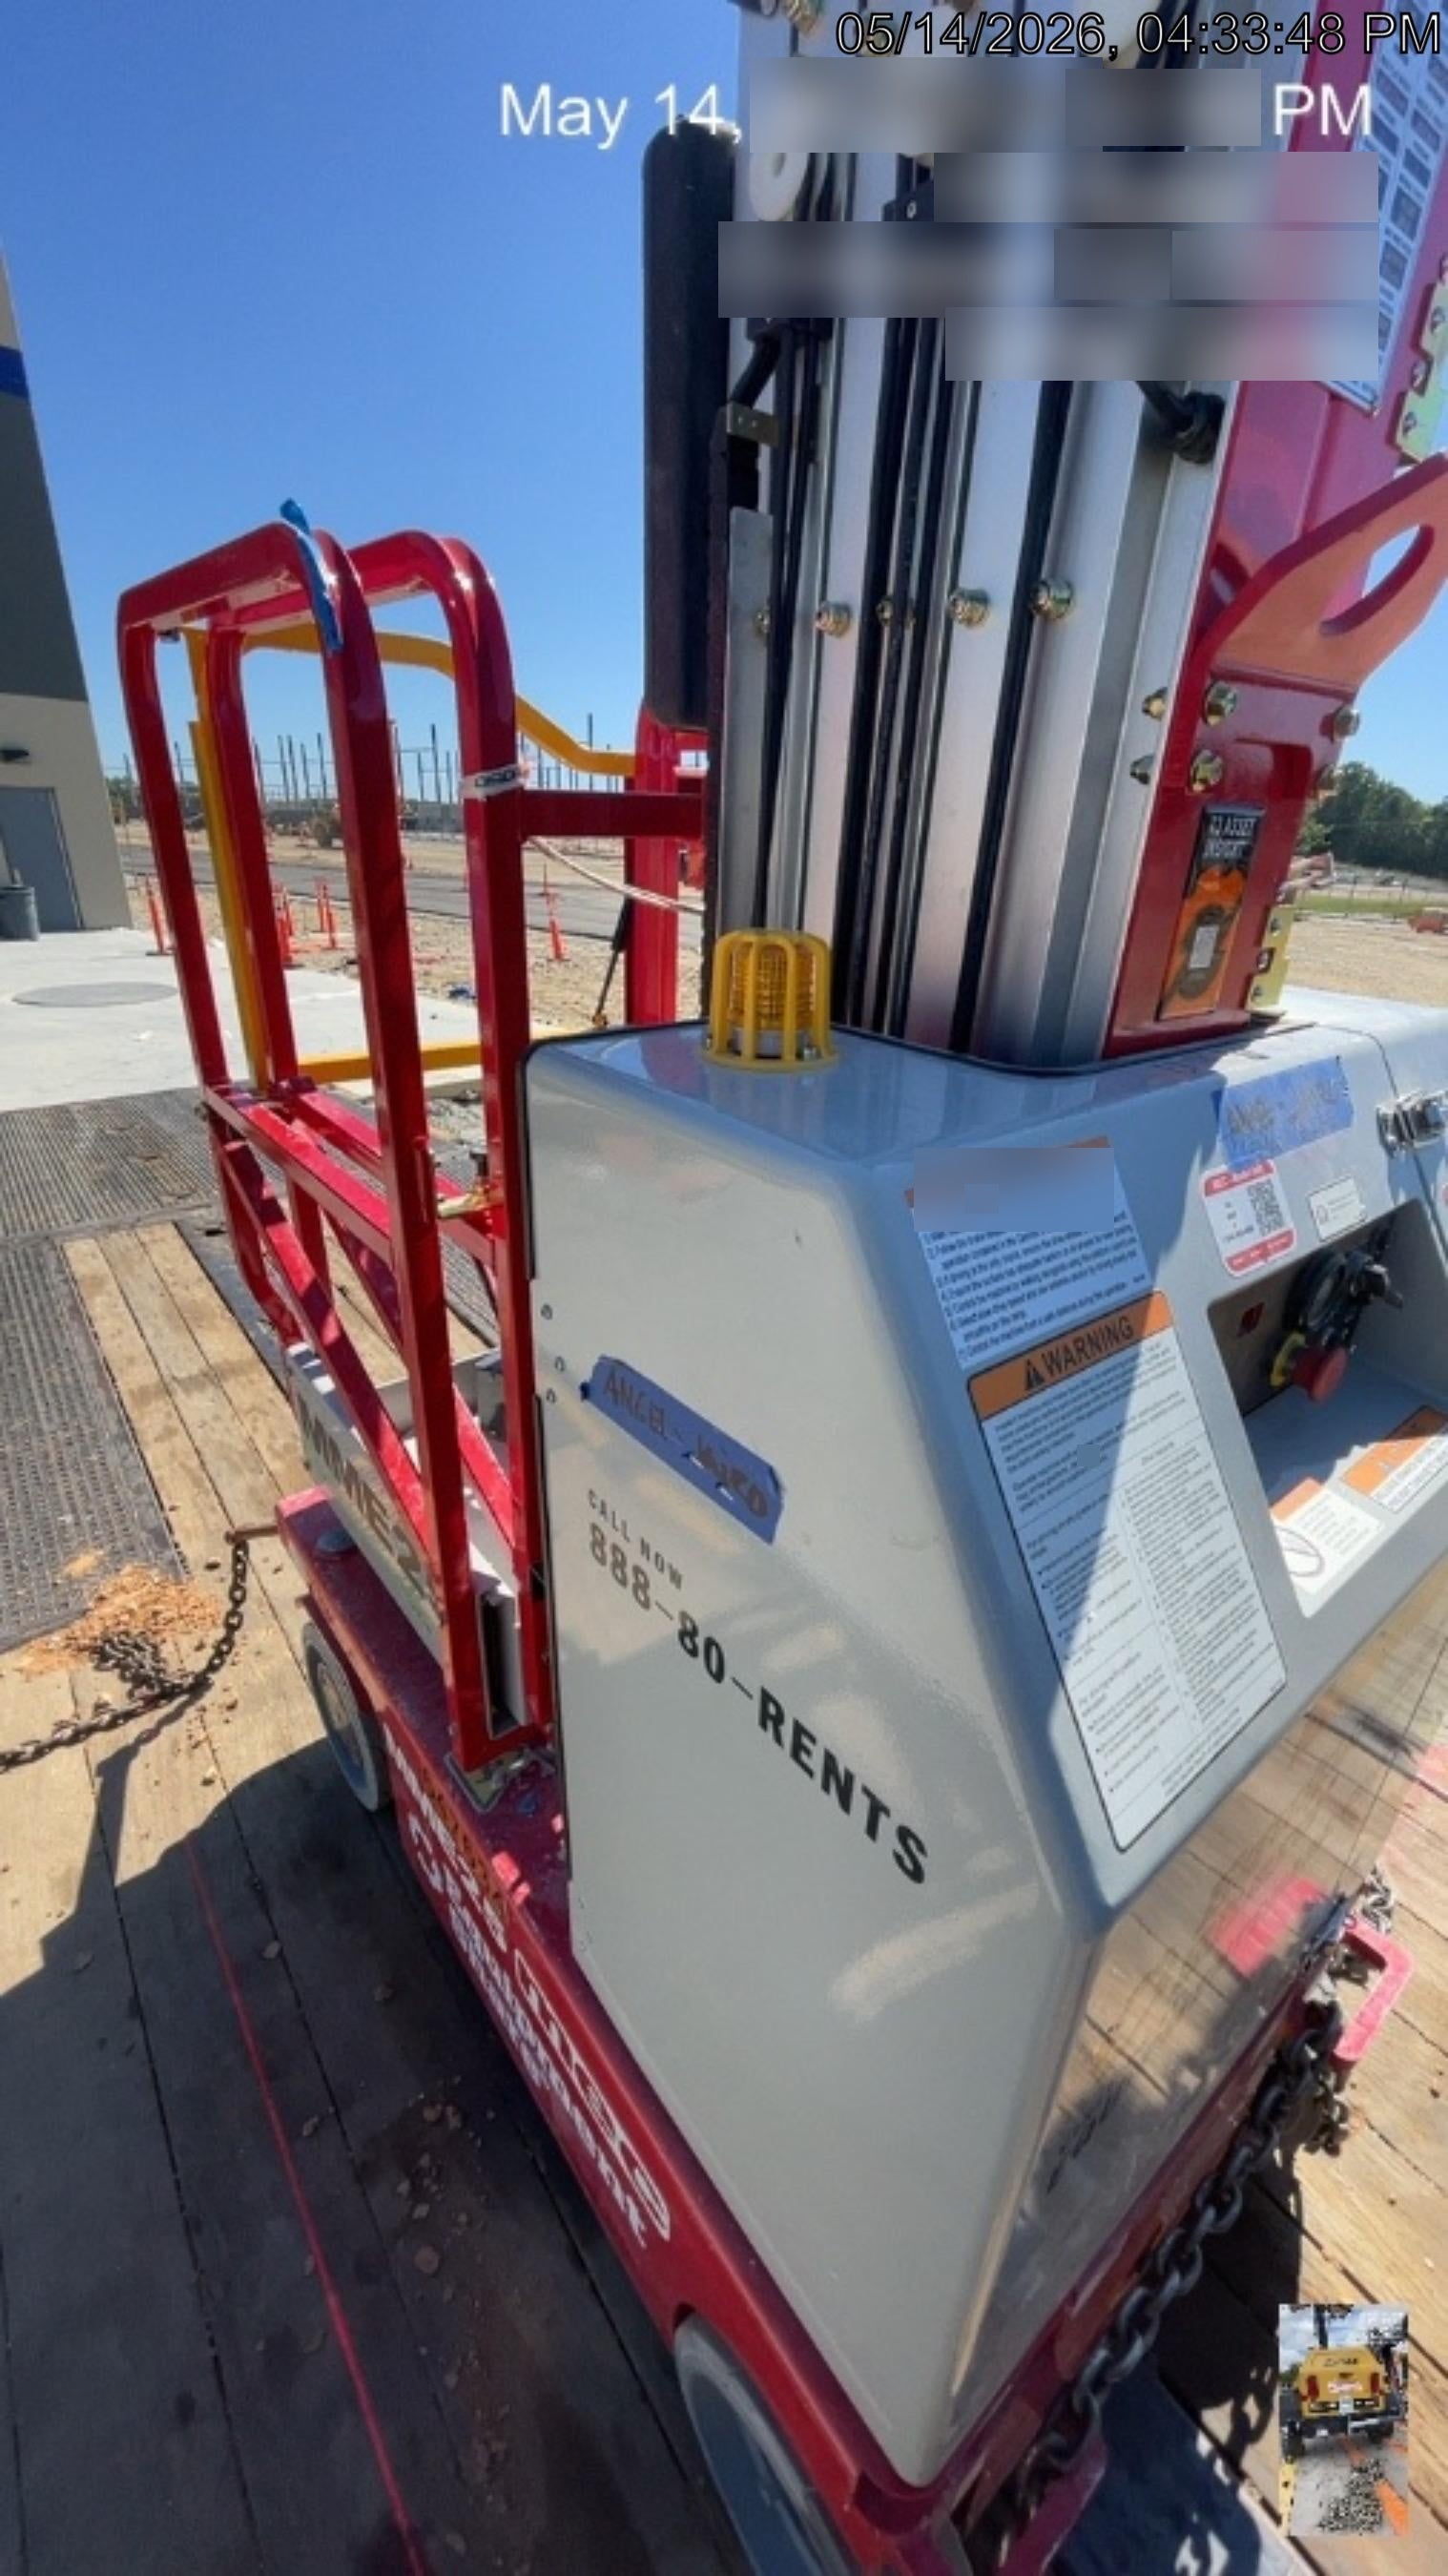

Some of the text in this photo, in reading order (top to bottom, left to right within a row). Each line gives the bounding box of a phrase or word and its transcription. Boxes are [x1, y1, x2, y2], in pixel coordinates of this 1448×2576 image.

[1042, 1316, 1134, 1377] WARNING
[588, 1488, 683, 1590] CALL NOW
[589, 1522, 927, 1885] 888-80-RENTS
